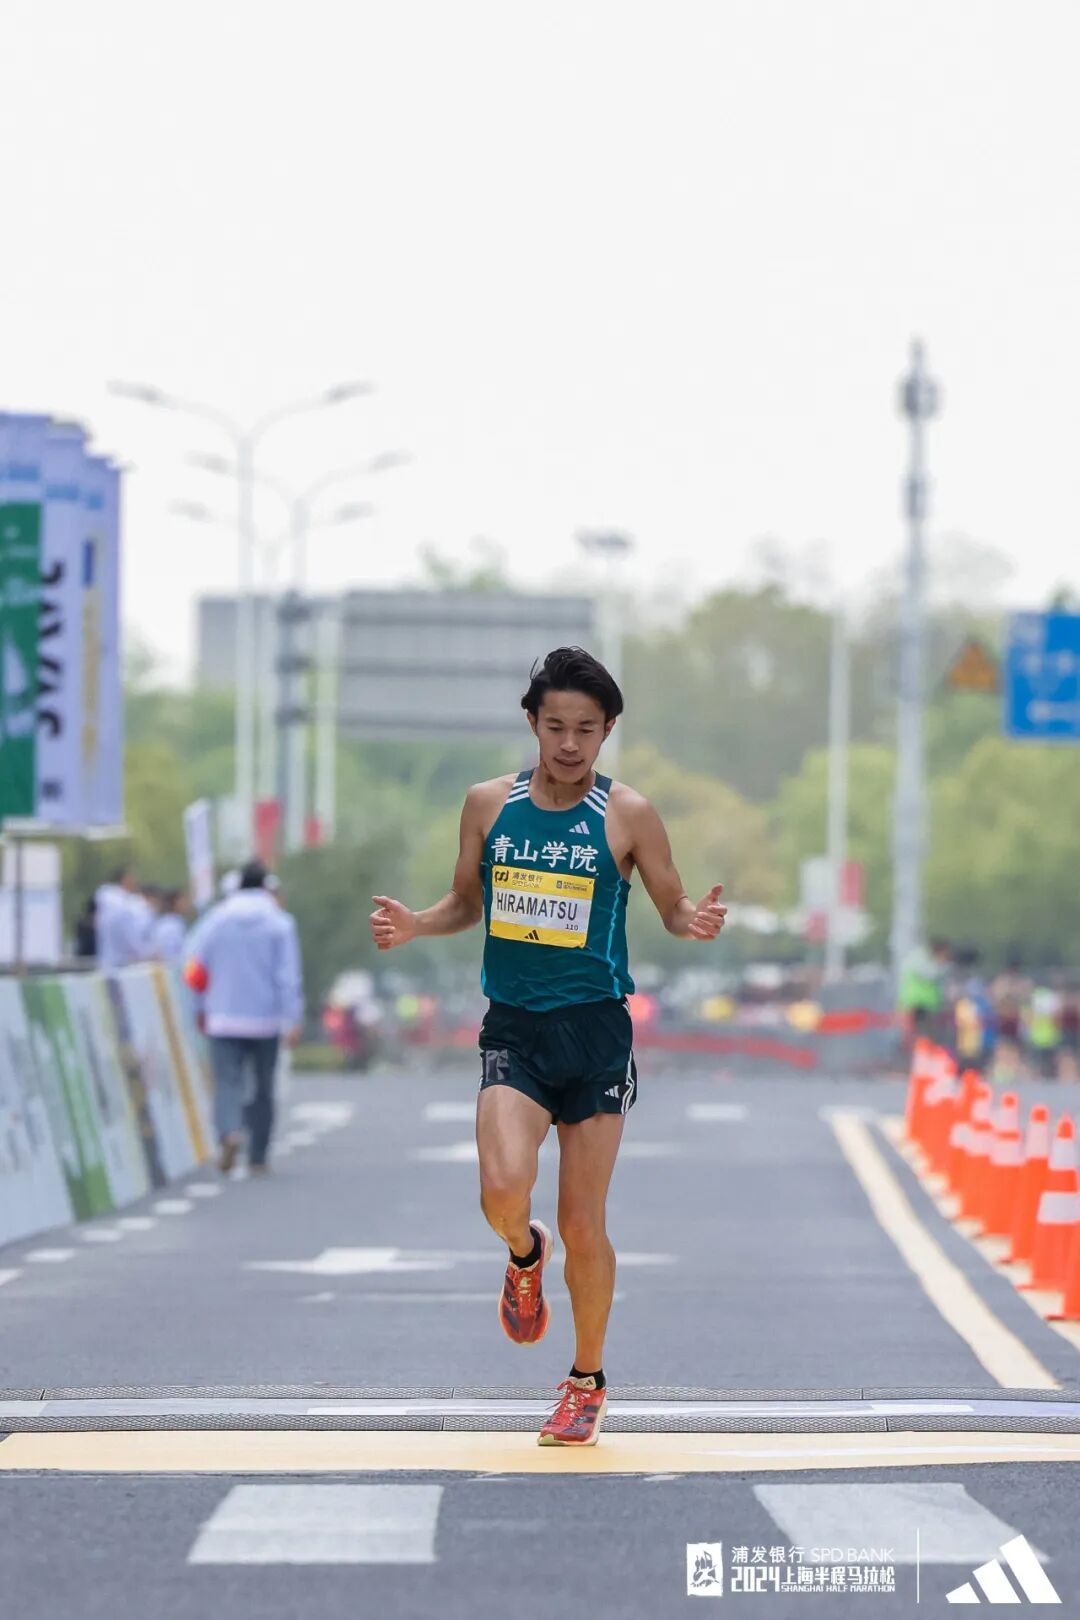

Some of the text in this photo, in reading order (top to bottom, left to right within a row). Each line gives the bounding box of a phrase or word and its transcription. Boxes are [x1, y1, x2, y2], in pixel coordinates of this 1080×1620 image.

[491, 834, 599, 872] 青山学院
[496, 891, 578, 921] HIRAMATSU
[565, 923, 579, 931] 110
